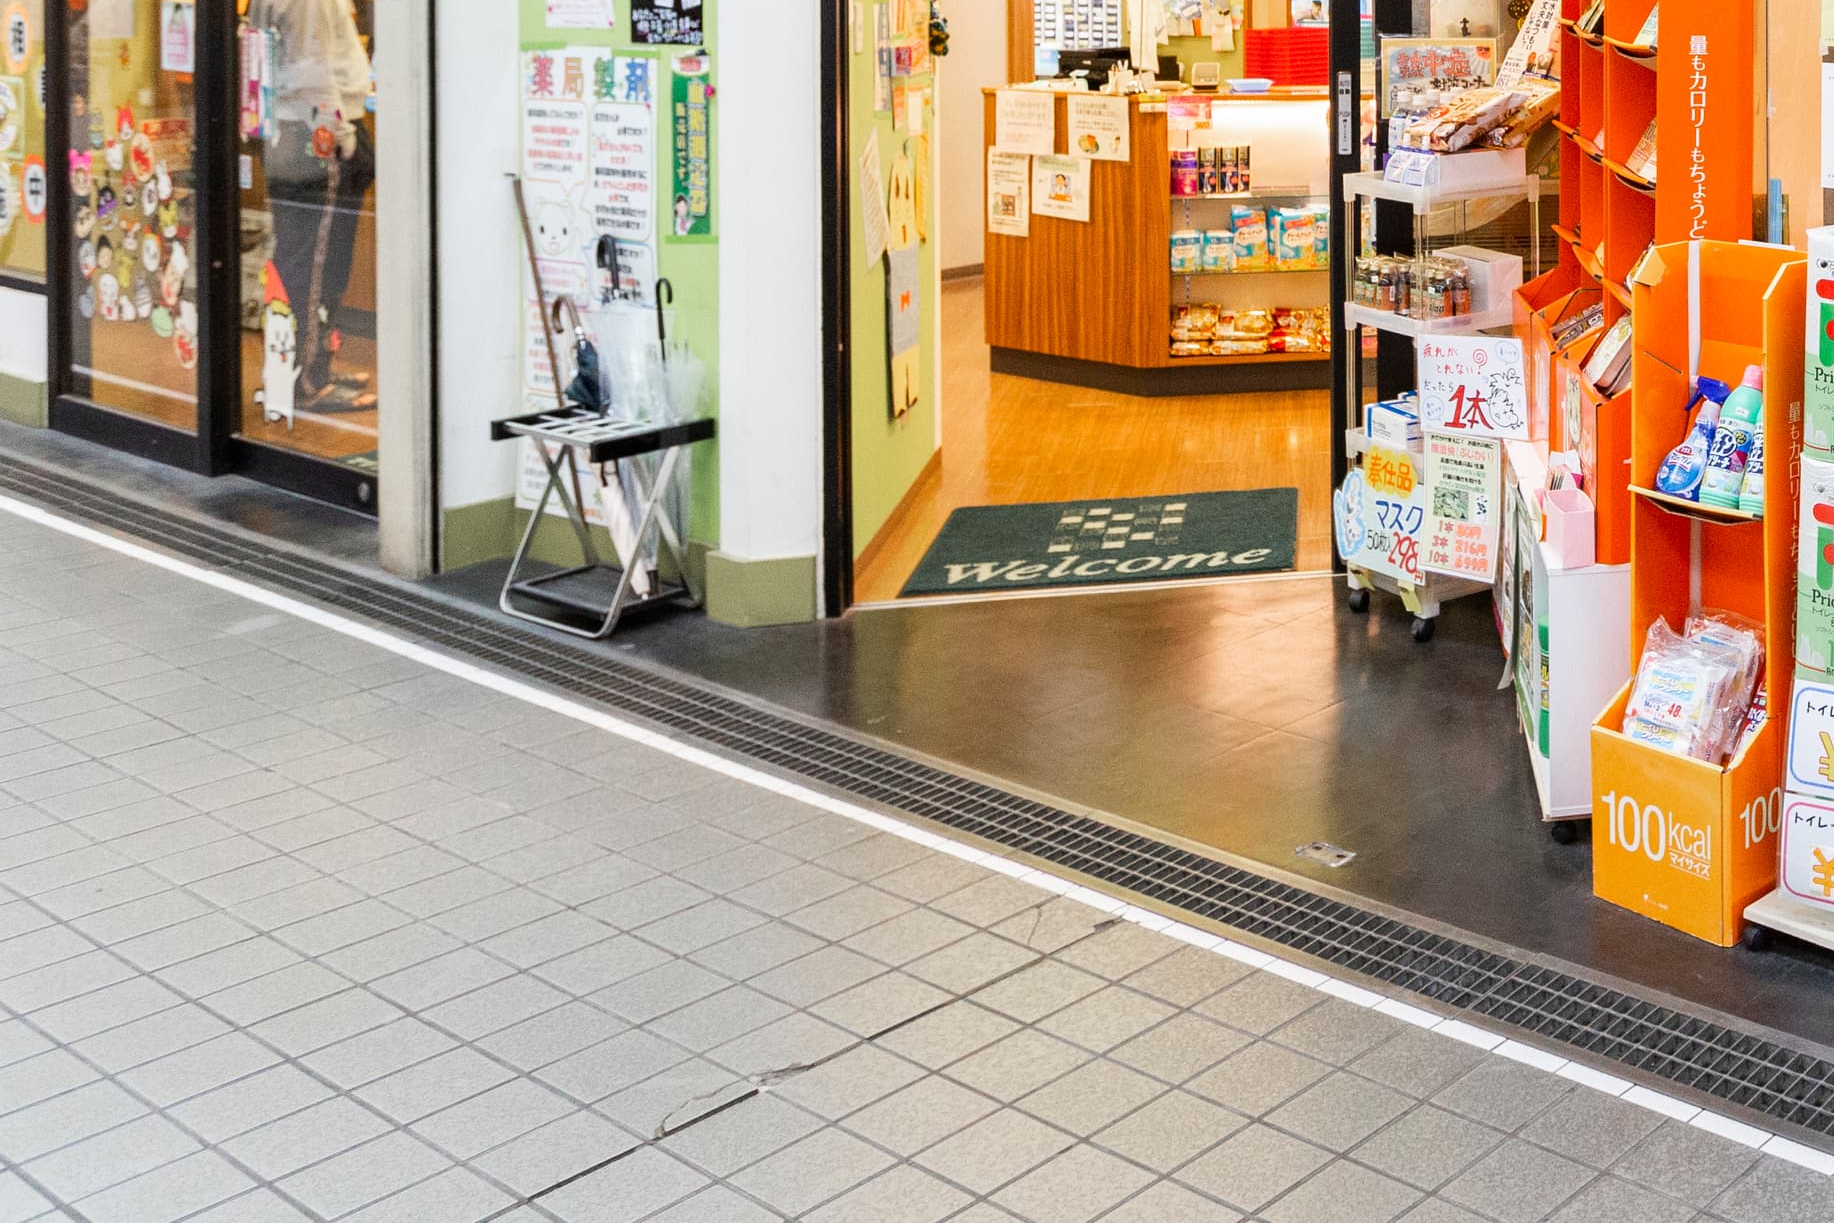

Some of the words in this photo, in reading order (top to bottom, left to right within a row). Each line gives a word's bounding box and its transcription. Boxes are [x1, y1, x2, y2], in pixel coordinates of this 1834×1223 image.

[1396, 47, 1473, 79] 熱中症
[1687, 35, 1710, 240] 量もカロリーもちょうど
[1444, 384, 1494, 431] 1本
[1367, 454, 1413, 493] 奉仕品
[1375, 499, 1424, 535] マスク
[1428, 550, 1449, 565] 10本
[1431, 535, 1449, 548] 3本
[943, 547, 1273, 585] Welcome
[1739, 786, 1782, 850] 100
[1670, 851, 1712, 878] マイサイズ
